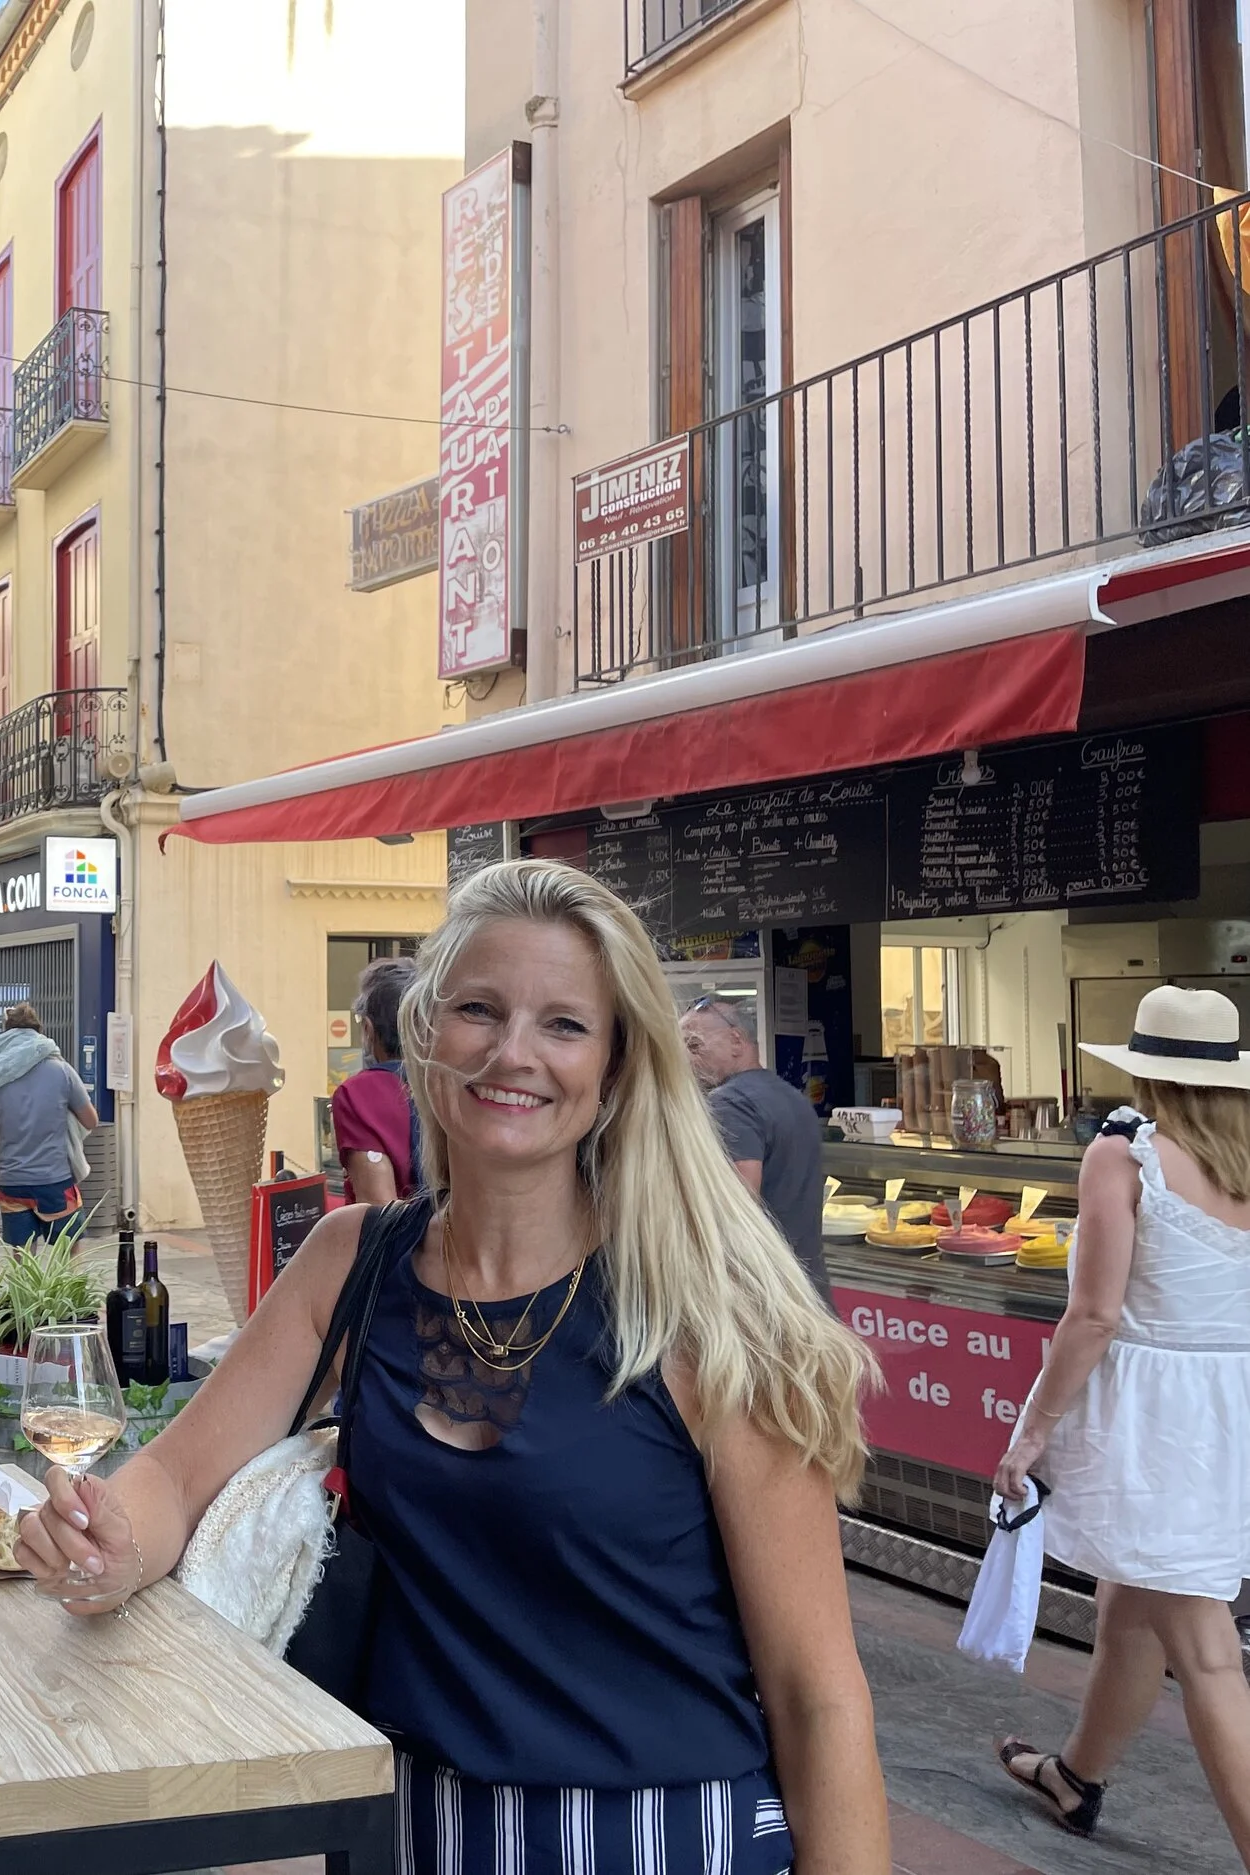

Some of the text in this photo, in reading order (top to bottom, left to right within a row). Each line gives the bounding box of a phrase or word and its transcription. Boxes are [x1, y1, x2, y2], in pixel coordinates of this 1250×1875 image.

[446, 188, 477, 659] RESTAURANT
[481, 392, 502, 572] PATIO
[581, 452, 682, 523] JIMENEZ
[600, 478, 681, 516] construction
[603, 494, 676, 525] Neuf Rénovation
[579, 506, 685, 552] 06 24 40 43 65
[1081, 738, 1144, 772] Gaufres
[798, 785, 815, 803] de
[819, 780, 874, 802] Louise
[455, 825, 494, 843] Louise
[924, 831, 955, 843] Nutella
[53, 886, 108, 899] FONCIA
[944, 892, 970, 907] votre
[850, 1306, 949, 1348] Glace
[967, 1330, 1011, 1361] au
[908, 1371, 950, 1407] de
